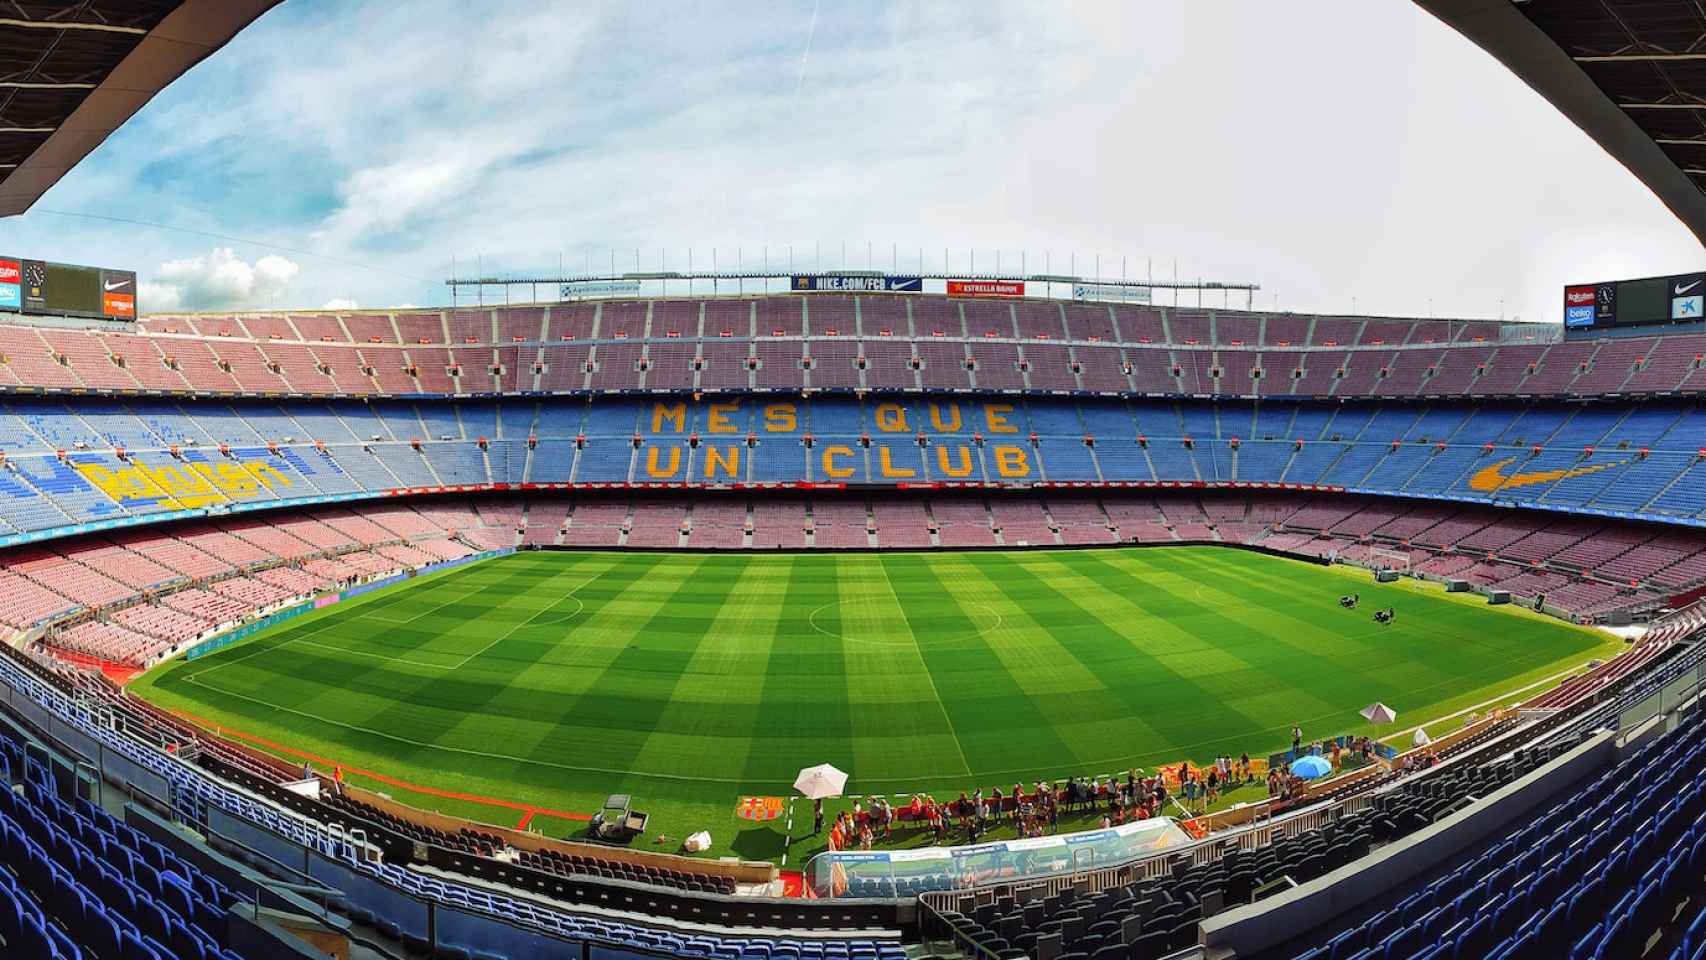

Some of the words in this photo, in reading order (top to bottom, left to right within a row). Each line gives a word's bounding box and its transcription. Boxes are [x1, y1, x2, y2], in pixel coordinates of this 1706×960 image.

[816, 278, 886, 290] NIKE.COM/FCB
[876, 408, 1017, 433] QUE
[647, 447, 739, 478] UN
[822, 446, 1030, 478] CLUB
